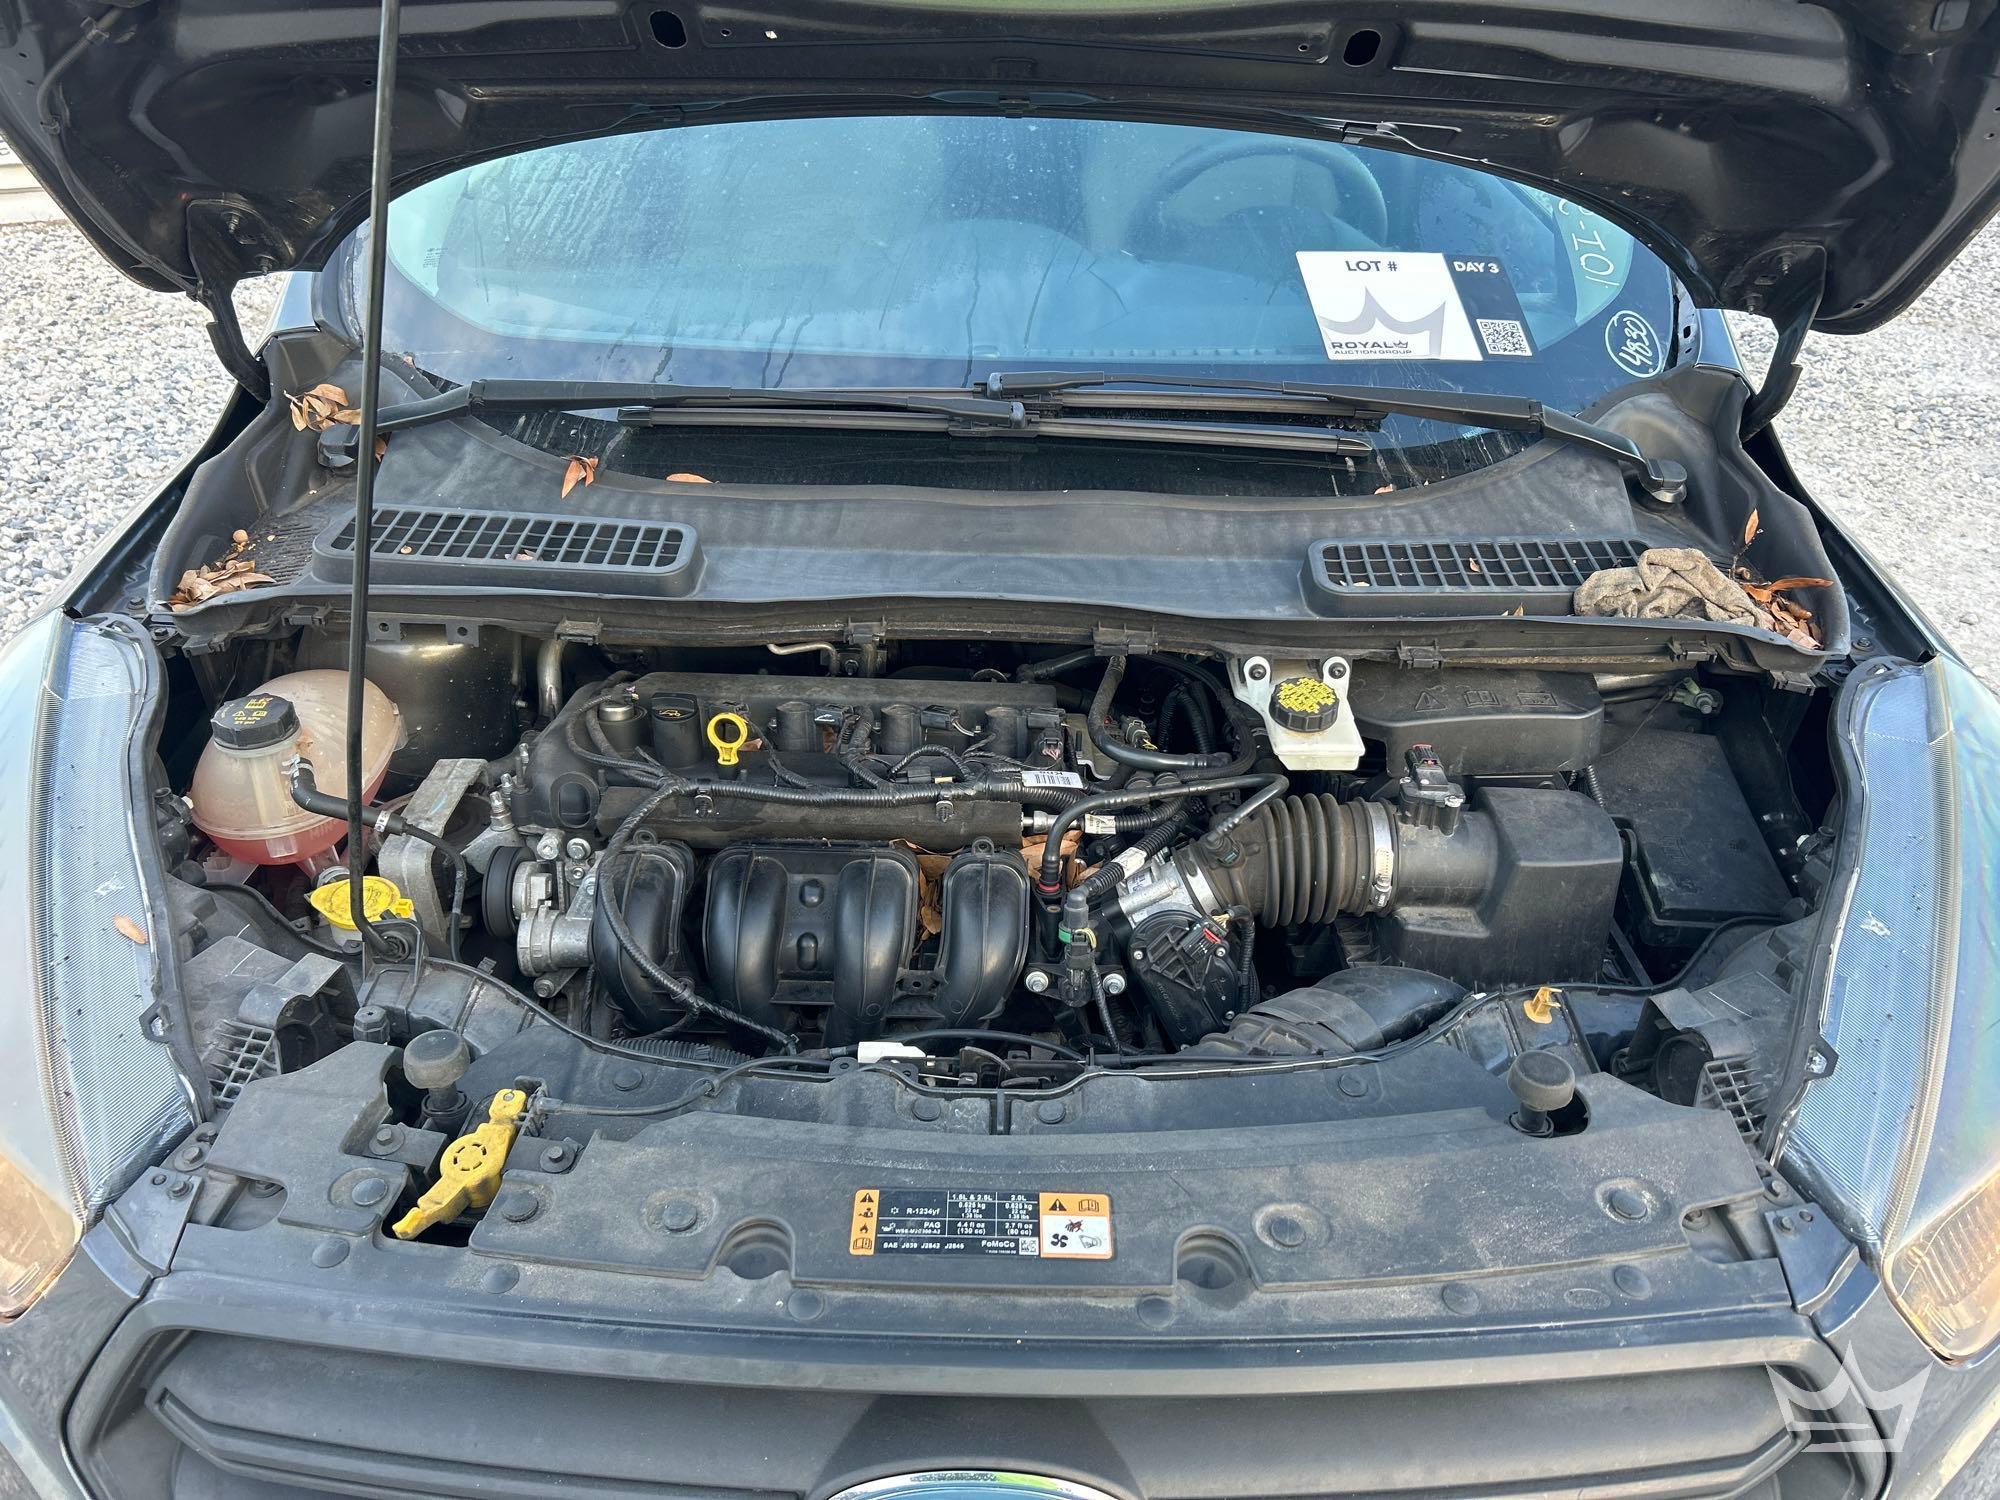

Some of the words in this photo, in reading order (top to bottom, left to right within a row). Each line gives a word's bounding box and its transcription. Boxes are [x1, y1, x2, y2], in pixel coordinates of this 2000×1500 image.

[1345, 260, 1381, 272] LOT
[1387, 260, 1398, 272] #
[1453, 261, 1485, 273] DAY
[1487, 262, 1500, 274] 3
[1331, 341, 1394, 349] ROYAL
[977, 1201, 986, 1210] kg
[1023, 1202, 1033, 1211] kg
[906, 1207, 941, 1216] R-1234yf
[923, 1221, 941, 1229] PAG
[981, 1239, 1016, 1248] FoMoCo
